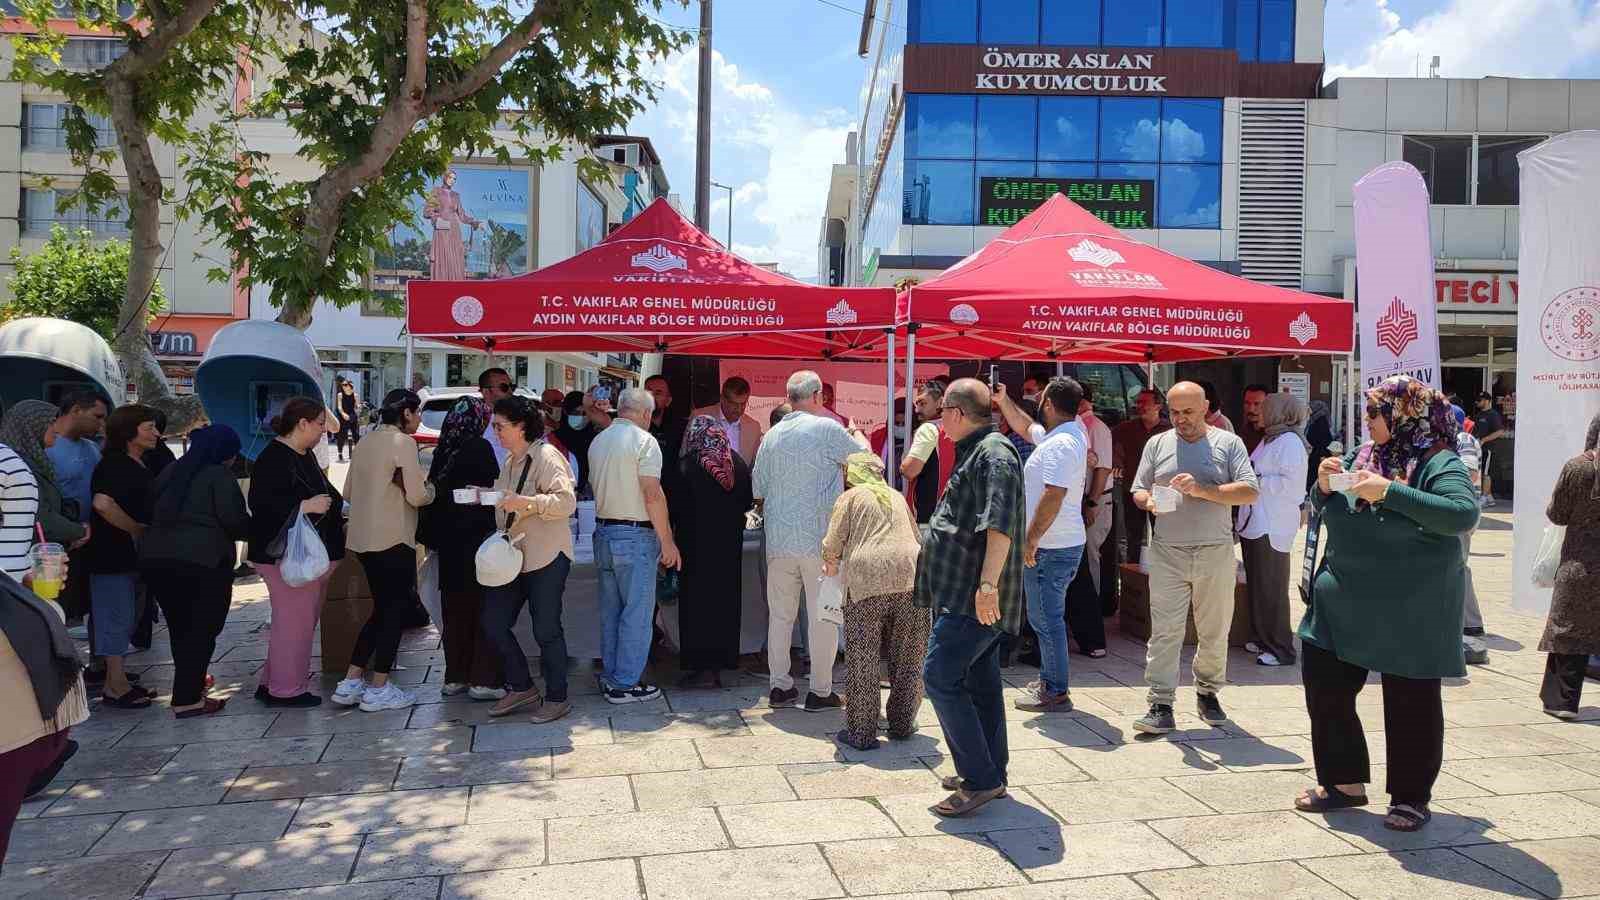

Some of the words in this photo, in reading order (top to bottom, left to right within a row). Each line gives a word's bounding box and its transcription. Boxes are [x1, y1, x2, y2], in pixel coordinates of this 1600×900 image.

[983, 47, 1061, 68] ÖMER
[1067, 53, 1153, 69] ASLAN
[976, 73, 1167, 92] KUYUMCULUK
[1068, 183, 1141, 202] ASLAN
[541, 295, 568, 308] T.C.
[573, 295, 638, 308] VAKIFLAR
[643, 297, 687, 309] GENEL
[691, 296, 776, 311] MÜDÜRLÜĞÜ
[532, 313, 575, 325] AYDIN
[580, 313, 645, 326] VAKIFLAR
[650, 312, 695, 326] BÖLGE
[700, 314, 784, 326] MÜDÜRLÜĞÜ
[1030, 305, 1055, 316] T.C.
[1058, 305, 1118, 317] VAKIFLAR
[1121, 306, 1162, 318] GENEL
[1166, 307, 1243, 323] MÜDÜRLÜĞÜ
[1022, 320, 1061, 330] AYDIN
[1065, 321, 1124, 333] VAKIFLAR
[1127, 321, 1170, 335] BÖLGE
[1173, 324, 1251, 339] MÜDÜRLÜĞÜ
